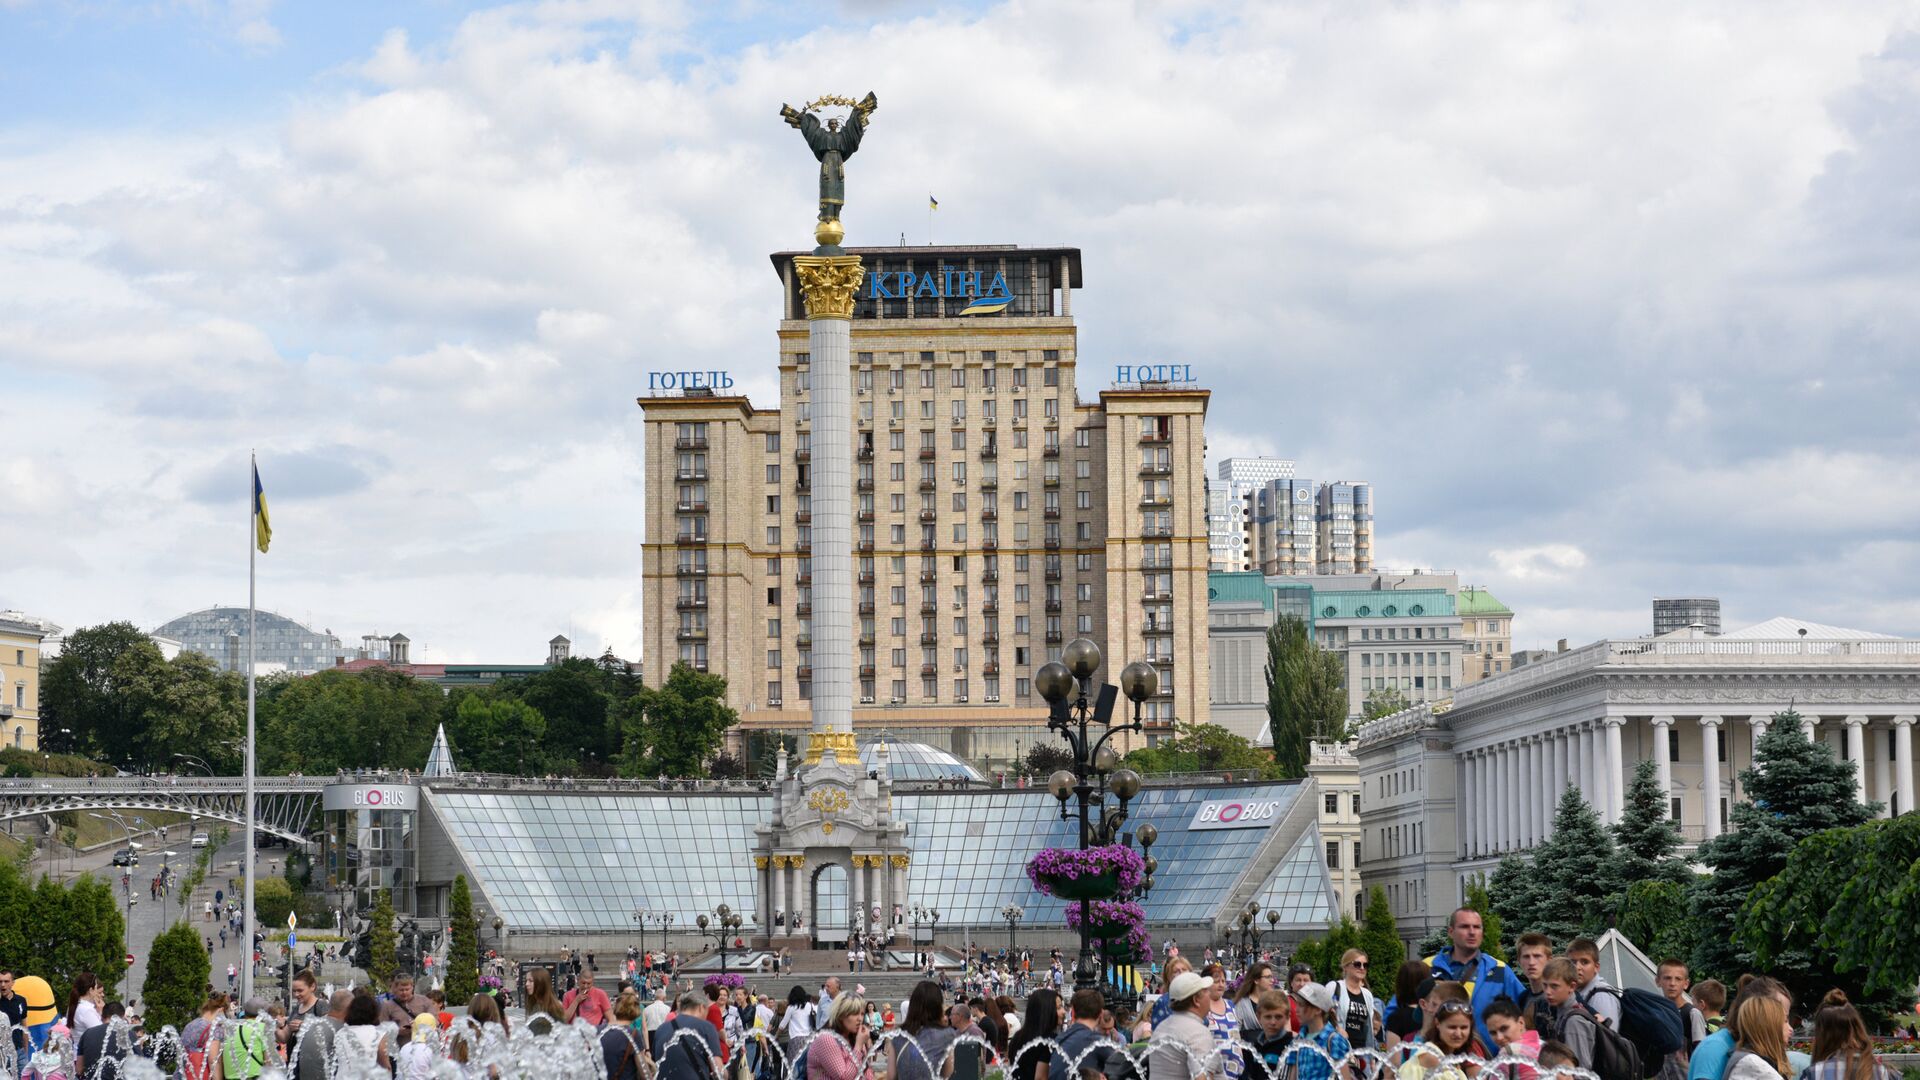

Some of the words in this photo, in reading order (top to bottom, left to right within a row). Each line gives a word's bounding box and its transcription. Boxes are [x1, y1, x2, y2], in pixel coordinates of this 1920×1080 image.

[867, 265, 1012, 298] КРАЇНА
[648, 371, 733, 389] ГОТЕЛЬ
[1116, 364, 1197, 383] HOTEL
[354, 789, 404, 806] GLOBUS
[1200, 801, 1279, 823] GLOBUS
